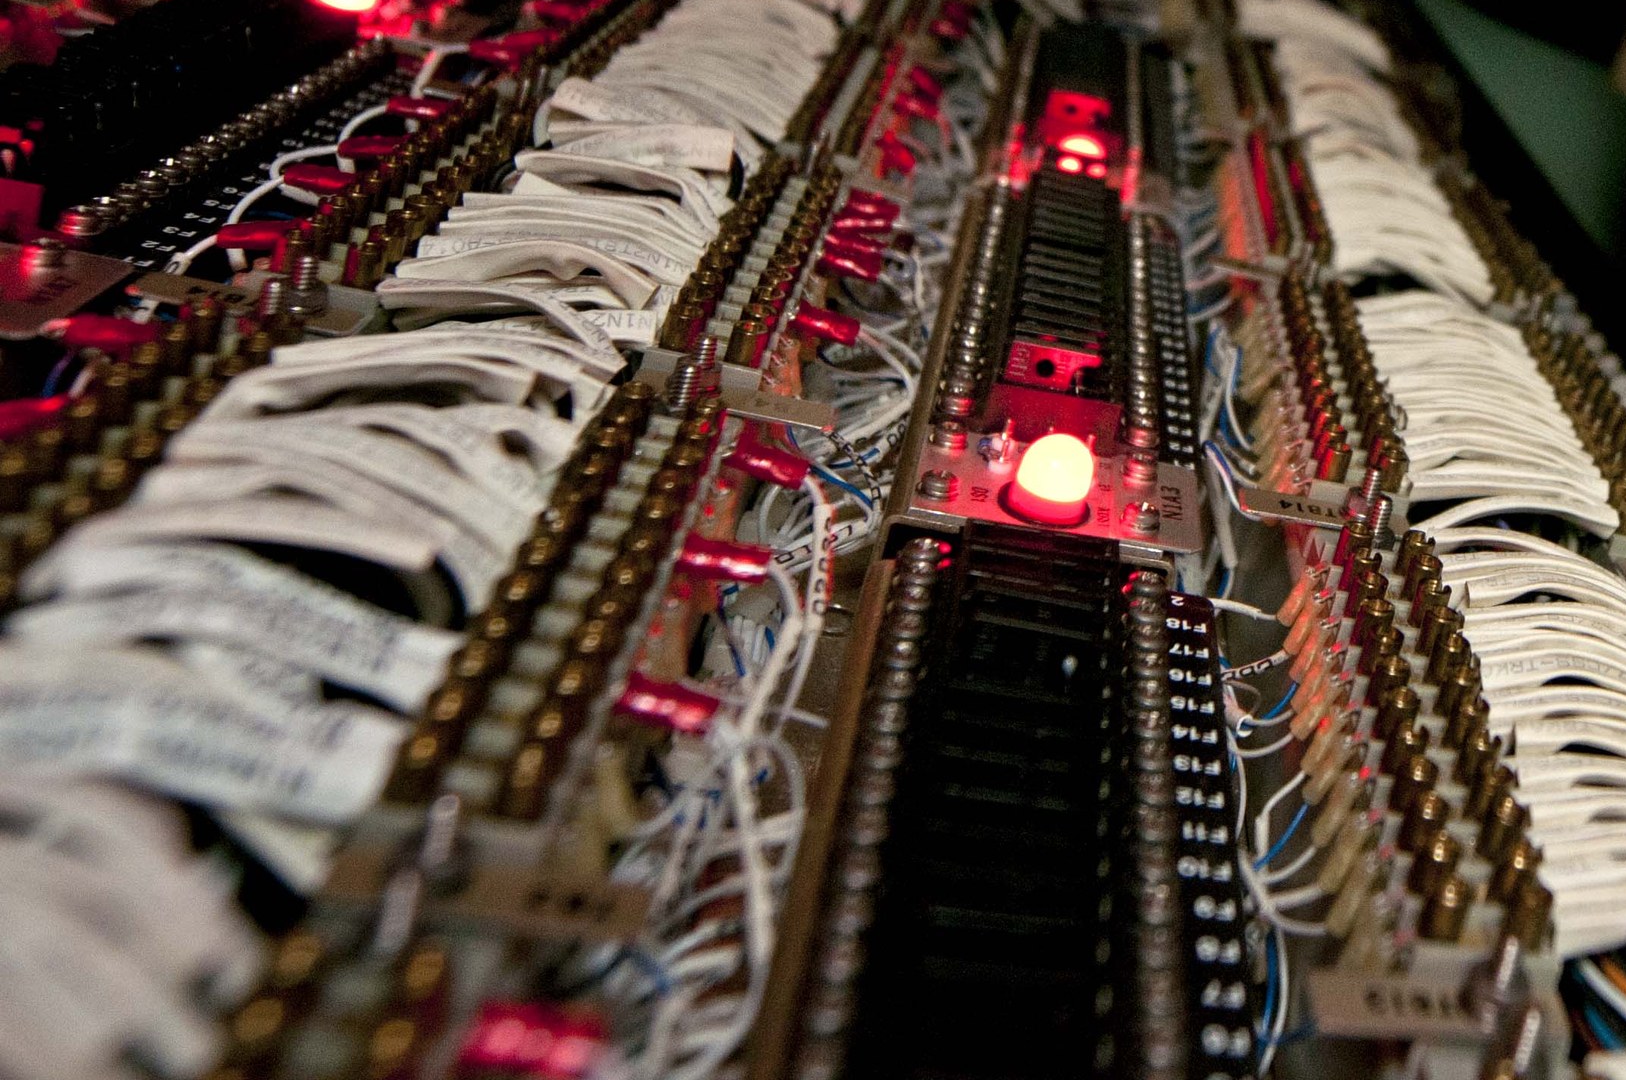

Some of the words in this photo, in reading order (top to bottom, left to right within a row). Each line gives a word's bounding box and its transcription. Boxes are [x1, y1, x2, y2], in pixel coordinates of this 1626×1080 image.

[203, 199, 236, 210] F5
[183, 212, 217, 223] F4
[162, 226, 197, 237] F3
[141, 240, 176, 252] F2
[123, 256, 155, 267] F1
[1168, 440, 1194, 454] F2
[1174, 458, 1196, 470] F1
[1161, 484, 1183, 521] N1A3
[1166, 617, 1207, 634] F18
[1169, 643, 1210, 659] F17
[1168, 668, 1213, 686] F16
[1170, 695, 1216, 714] F15
[1171, 724, 1218, 744] F14
[1173, 754, 1221, 776] F13
[1175, 786, 1225, 809] F12
[1182, 821, 1228, 845] F11
[1177, 855, 1232, 882] F10
[1201, 978, 1247, 1009] F7
